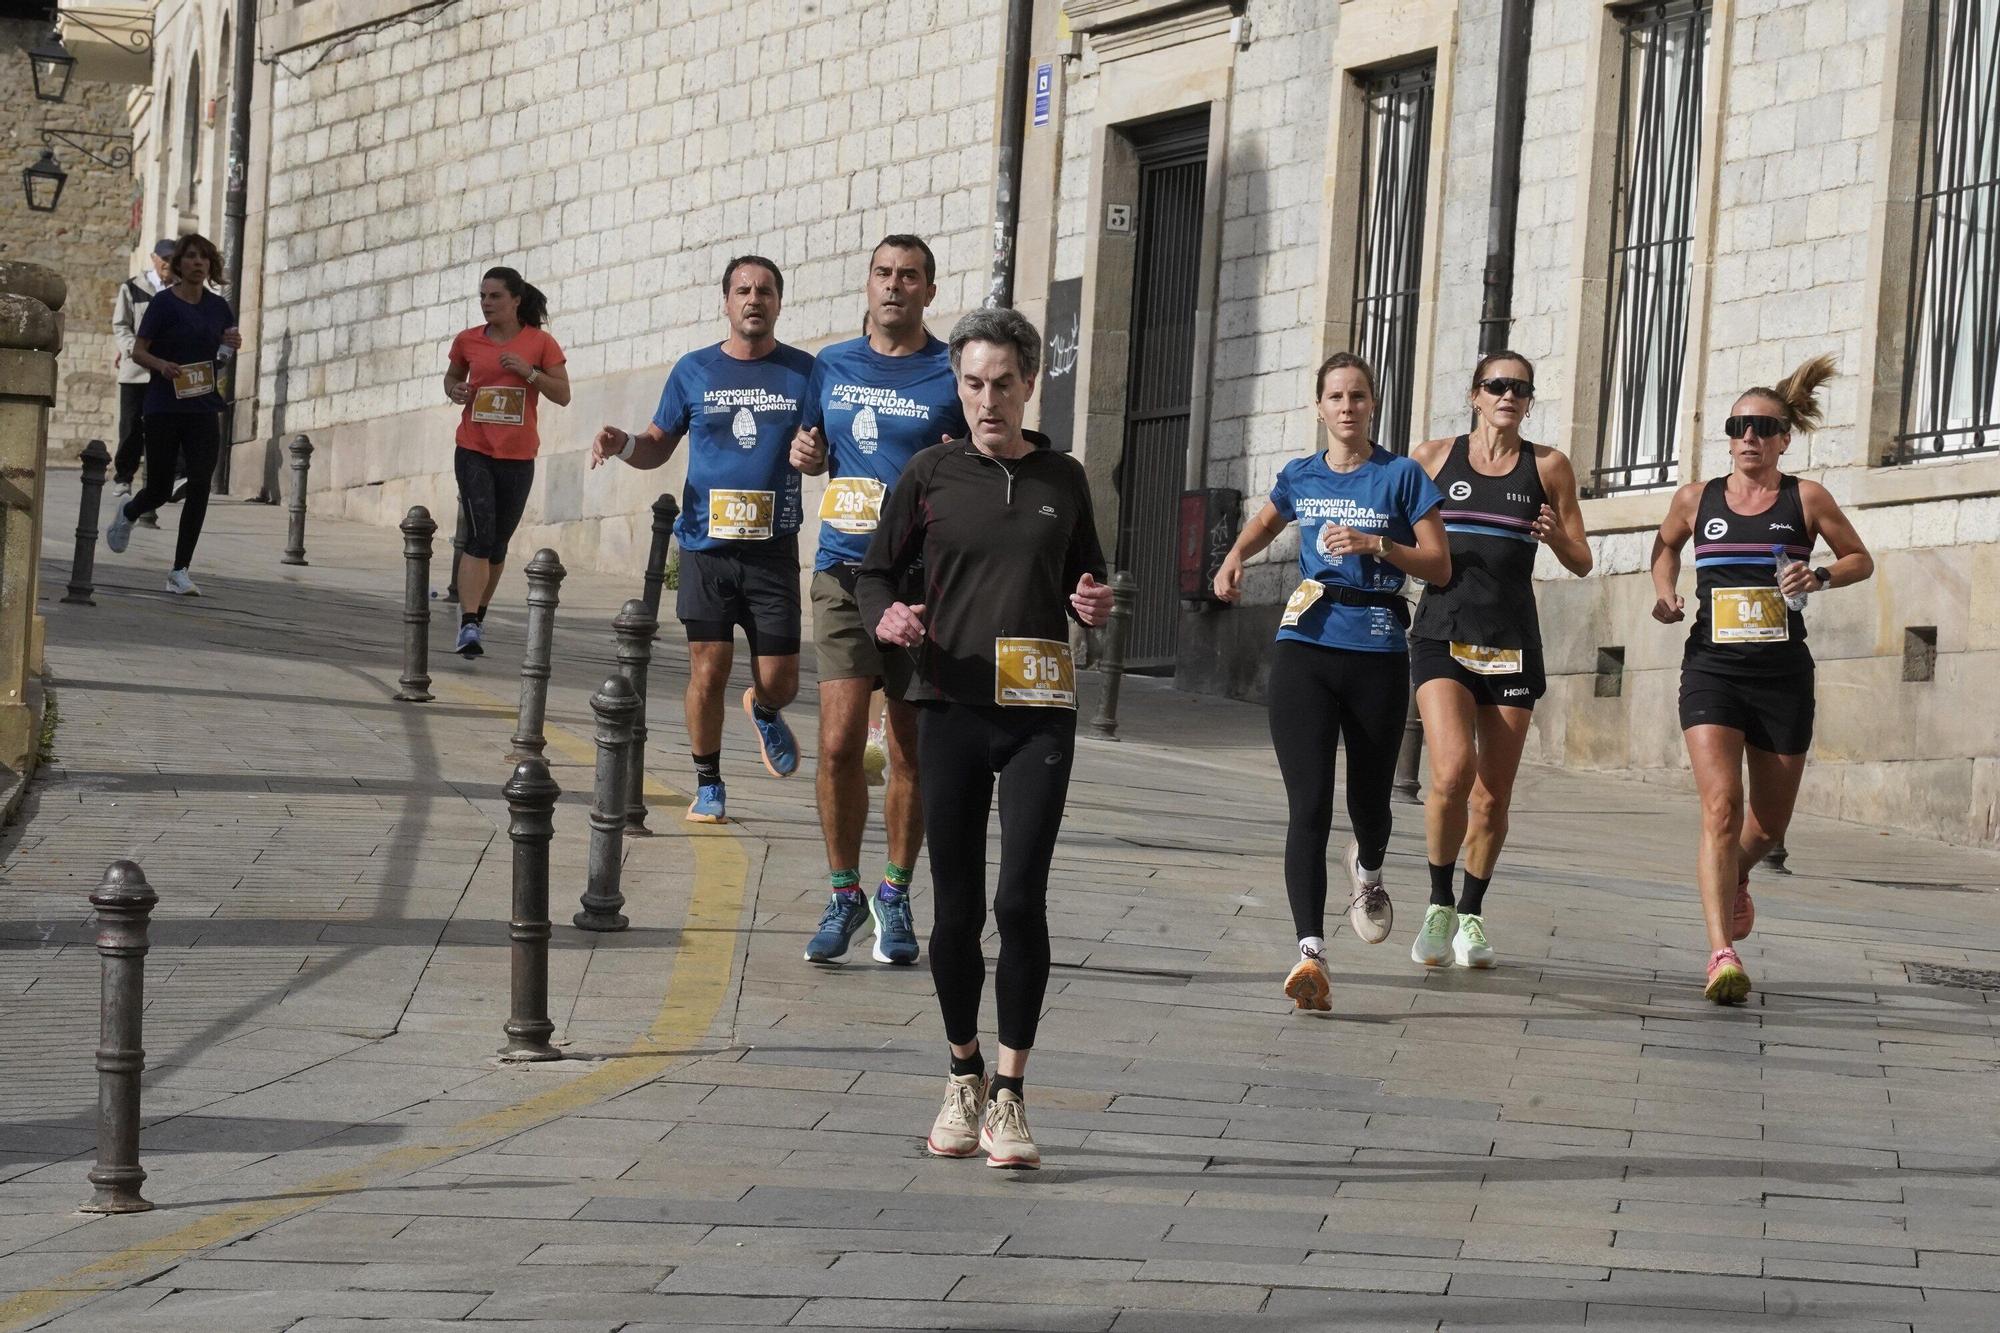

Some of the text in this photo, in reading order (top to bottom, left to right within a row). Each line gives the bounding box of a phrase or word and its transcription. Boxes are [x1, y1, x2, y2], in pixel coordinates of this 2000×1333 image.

[715, 388, 766, 397] CONQUISTA
[843, 385, 897, 398] CONQUISTA
[491, 395, 508, 410] 47
[717, 394, 785, 406] ALMENDRA
[841, 393, 915, 409] ALMENDRA
[754, 403, 798, 412] KONKISTA
[878, 406, 929, 420] KONKISTA
[834, 491, 865, 513] 293
[1296, 498, 1357, 508] LA CONQUISTA
[1506, 492, 1531, 503] GOBIK
[725, 502, 757, 521] 420
[1305, 506, 1375, 519] ALMENDRA
[1340, 518, 1389, 528] KONKISTA
[1737, 601, 1763, 622] 94
[1023, 655, 1060, 681] 315
[1503, 688, 1530, 697] HOKA
